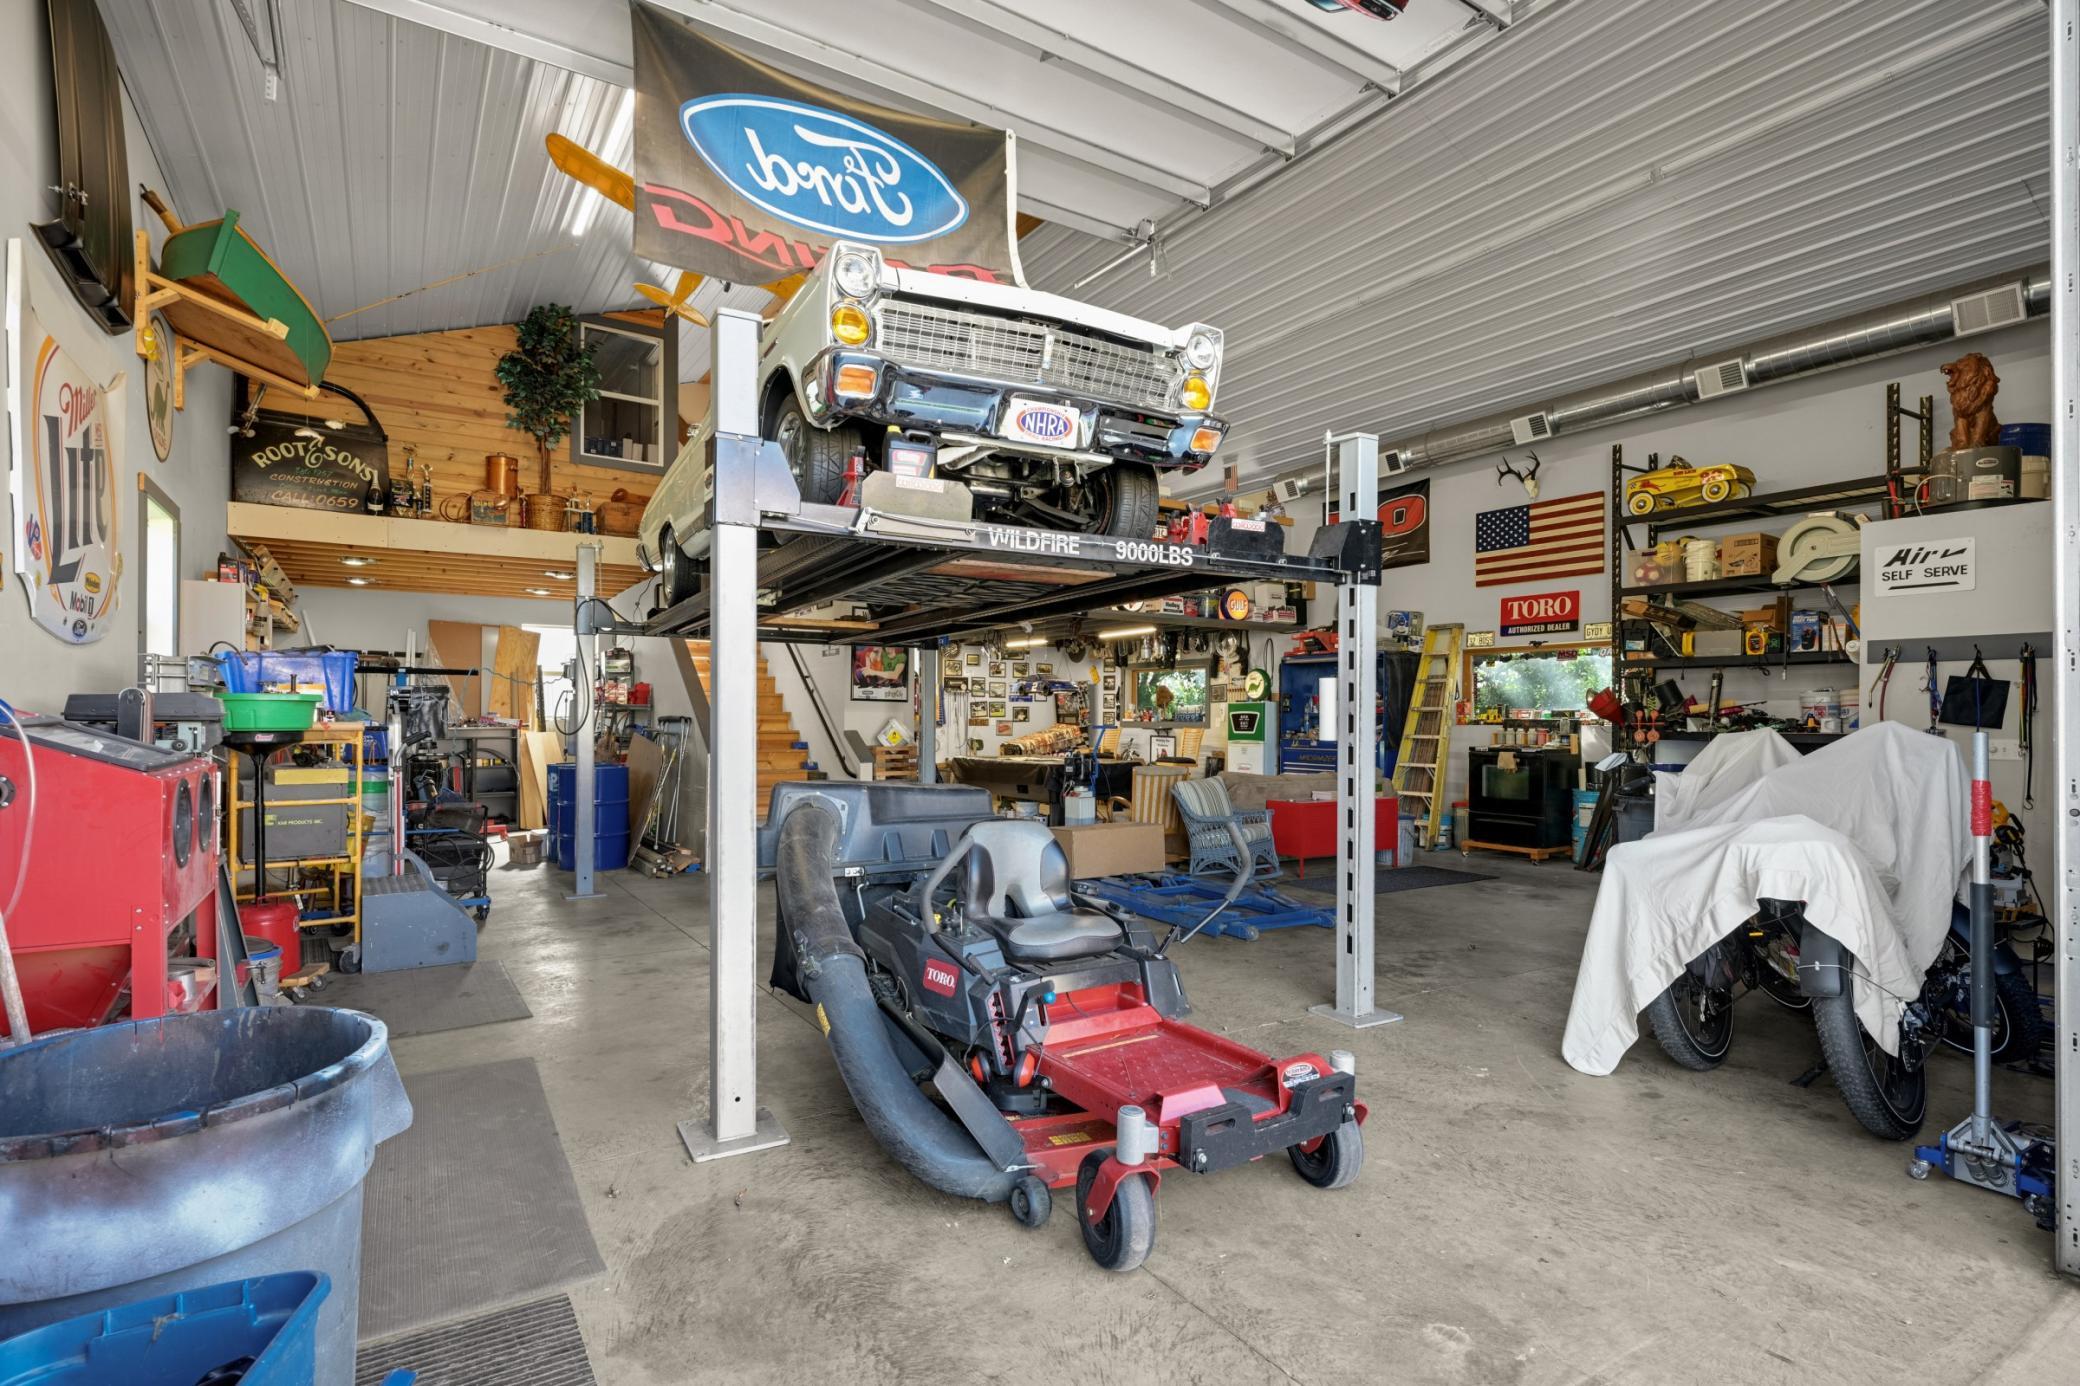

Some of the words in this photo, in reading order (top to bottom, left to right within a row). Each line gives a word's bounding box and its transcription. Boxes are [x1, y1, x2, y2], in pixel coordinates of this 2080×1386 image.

[59, 382, 97, 438] Miller
[1024, 412, 1065, 436] NHRA
[251, 442, 307, 468] ROOT
[323, 446, 373, 481] SONS
[269, 473, 359, 489] CONSTRUCTION
[42, 414, 108, 585] Lite
[988, 526, 1080, 556] WILDFIRE
[1115, 540, 1194, 567] 9000LBS
[1882, 546, 1939, 568] Air
[1881, 569, 1913, 582] SELF
[1923, 564, 1968, 578] SERVE
[70, 591, 88, 614] Mobil
[1229, 599, 1248, 610] GULF
[1507, 596, 1572, 620] TORO
[1507, 624, 1545, 635] AUTHORIZED
[1546, 622, 1571, 632] DEALER
[927, 967, 955, 987] TORO
